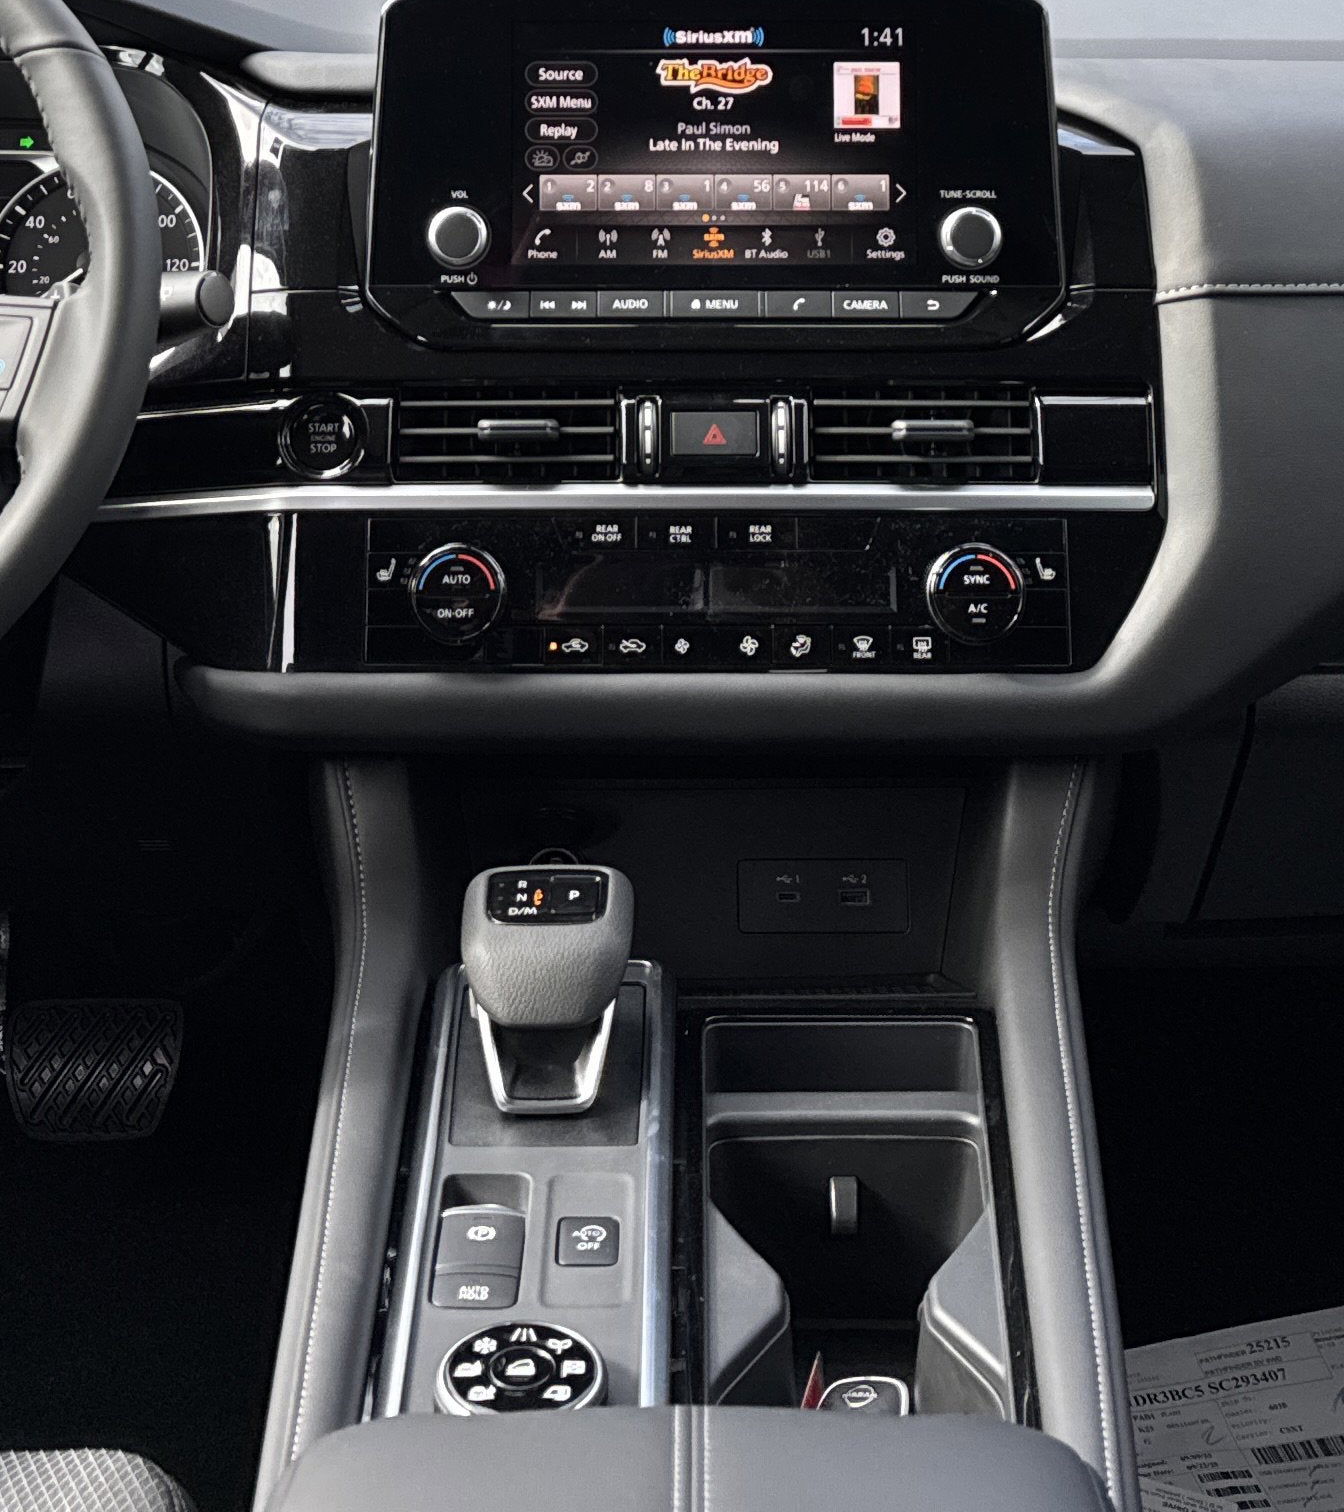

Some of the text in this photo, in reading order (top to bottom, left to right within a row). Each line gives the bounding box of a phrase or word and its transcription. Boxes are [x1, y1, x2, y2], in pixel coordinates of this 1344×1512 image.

[860, 27, 904, 46] 1:41
[538, 67, 584, 81] Source
[530, 95, 592, 109] SXM Menu
[692, 96, 734, 110] Ch. 27
[540, 123, 578, 139] Replay
[677, 121, 751, 135] Paul Simon
[834, 132, 876, 143] Live Mode
[649, 138, 779, 154] Late In The Evening
[586, 180, 595, 192] 2
[643, 180, 654, 192] 8
[704, 180, 711, 192] 1
[753, 179, 770, 192] 56
[804, 179, 829, 192] 114
[880, 179, 887, 192] 1
[451, 190, 468, 199] VOL
[939, 190, 997, 199] TUNE-SCROLL
[25, 214, 45, 229] 40
[158, 214, 177, 228] 00
[527, 249, 558, 259] Phone
[598, 249, 617, 259] AM
[652, 249, 668, 259] FM
[692, 249, 735, 259] SiriusXM
[744, 249, 789, 259] BT Audio
[866, 249, 905, 261] Settings
[8, 260, 27, 274] 20
[165, 258, 190, 272] 120
[440, 274, 465, 284] PUSH
[941, 274, 999, 284] PUSH SOUND
[612, 299, 648, 310] AUDIO
[705, 299, 738, 310] MENU
[843, 299, 888, 310] CAMERA
[308, 422, 340, 433] START
[310, 443, 337, 453] STOP
[596, 524, 619, 533] REAR
[669, 525, 692, 534] REAR
[749, 525, 772, 533] REAR
[669, 534, 691, 543] CTRL
[749, 533, 772, 542] LOCK
[441, 574, 471, 585] AUTO
[963, 575, 991, 585] SYNC
[968, 603, 989, 614] A/C
[852, 650, 876, 659] FRONT
[913, 651, 932, 659] REAR
[517, 880, 528, 889] R
[516, 893, 528, 902] N
[568, 889, 580, 901] P
[508, 907, 537, 916] D/M
[576, 1242, 601, 1250] OFF
[459, 1285, 489, 1293] AUTO
[1199, 1336, 1291, 1364] PATHFINDER 25215
[1207, 1367, 1287, 1396] SC293407
